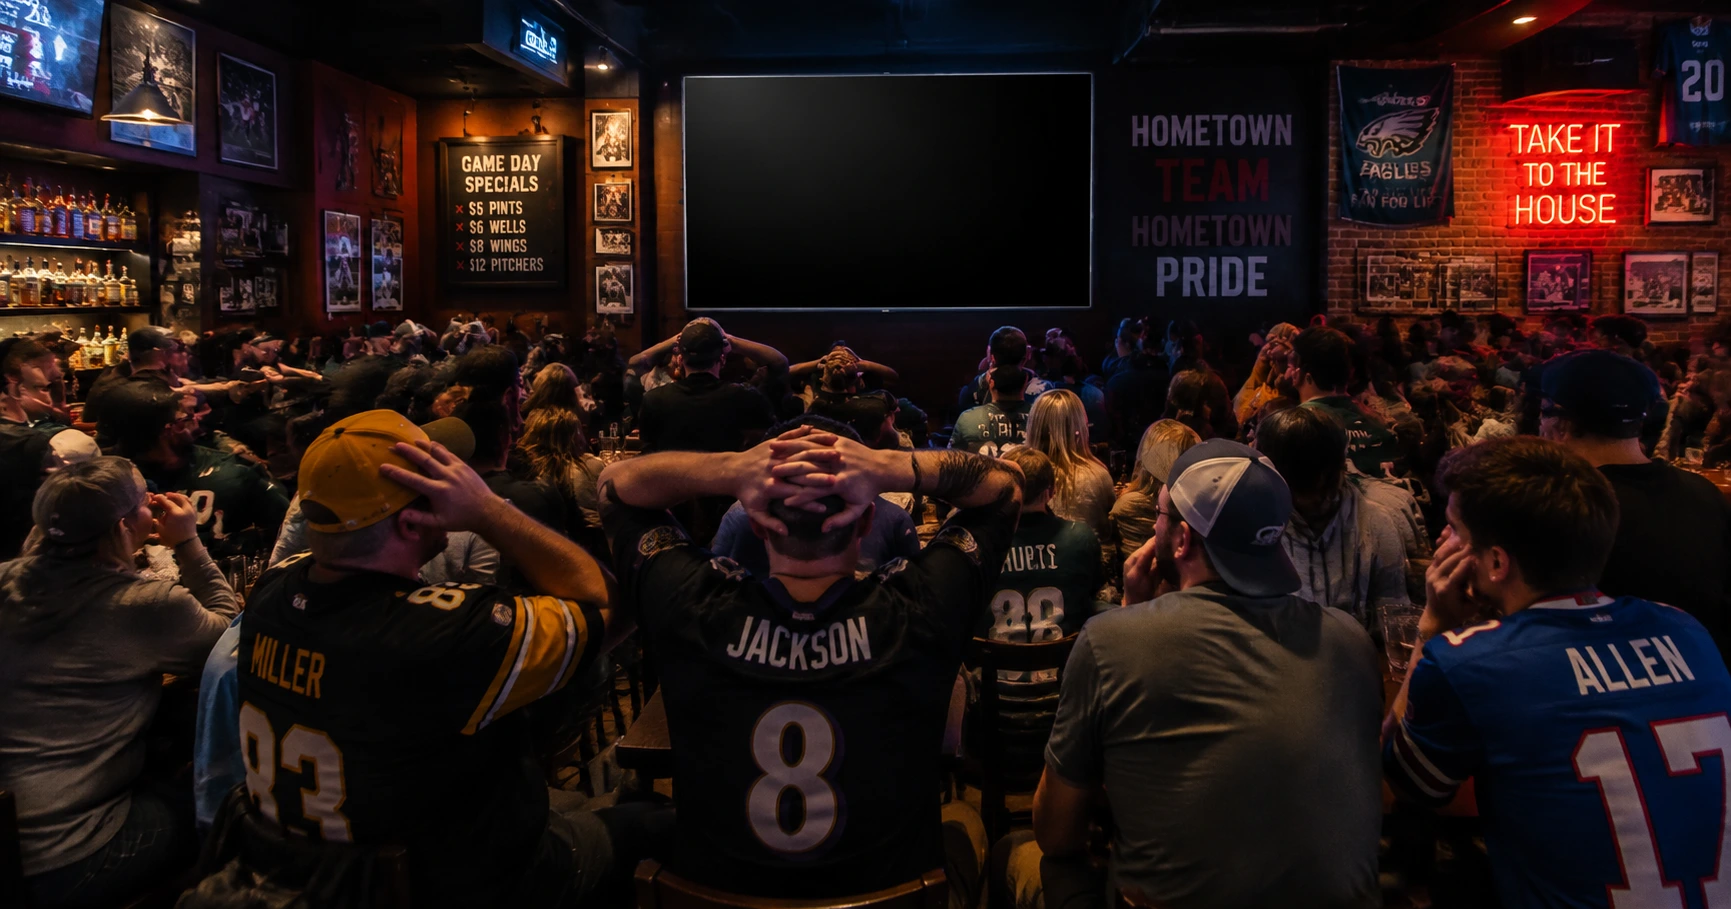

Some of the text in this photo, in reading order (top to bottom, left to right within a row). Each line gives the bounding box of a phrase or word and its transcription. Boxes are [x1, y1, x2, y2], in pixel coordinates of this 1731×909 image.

[1681, 59, 1725, 102] 20
[1131, 114, 1292, 147] HOMETOWN
[1509, 123, 1621, 154] TAKE IT
[461, 154, 541, 172] GAME DAY
[1155, 157, 1269, 202] TEAM
[1522, 161, 1607, 187] TO THE
[465, 175, 539, 193] SPECIALS
[489, 200, 523, 215] PINTS
[1515, 193, 1617, 225] HOUSE
[469, 219, 526, 234] $6 WELLS
[1131, 214, 1292, 247] HOMETOWN
[469, 238, 528, 253] $8 WINGS
[469, 257, 544, 272] $12 PITCHERS
[1156, 256, 1268, 297] PRIDE
[726, 615, 872, 671] JACKSON
[251, 632, 326, 699] MILLER
[1565, 635, 1695, 696] ALLEN
[238, 699, 354, 843] 83
[746, 700, 839, 854] 8
[1570, 710, 1731, 909] 17
